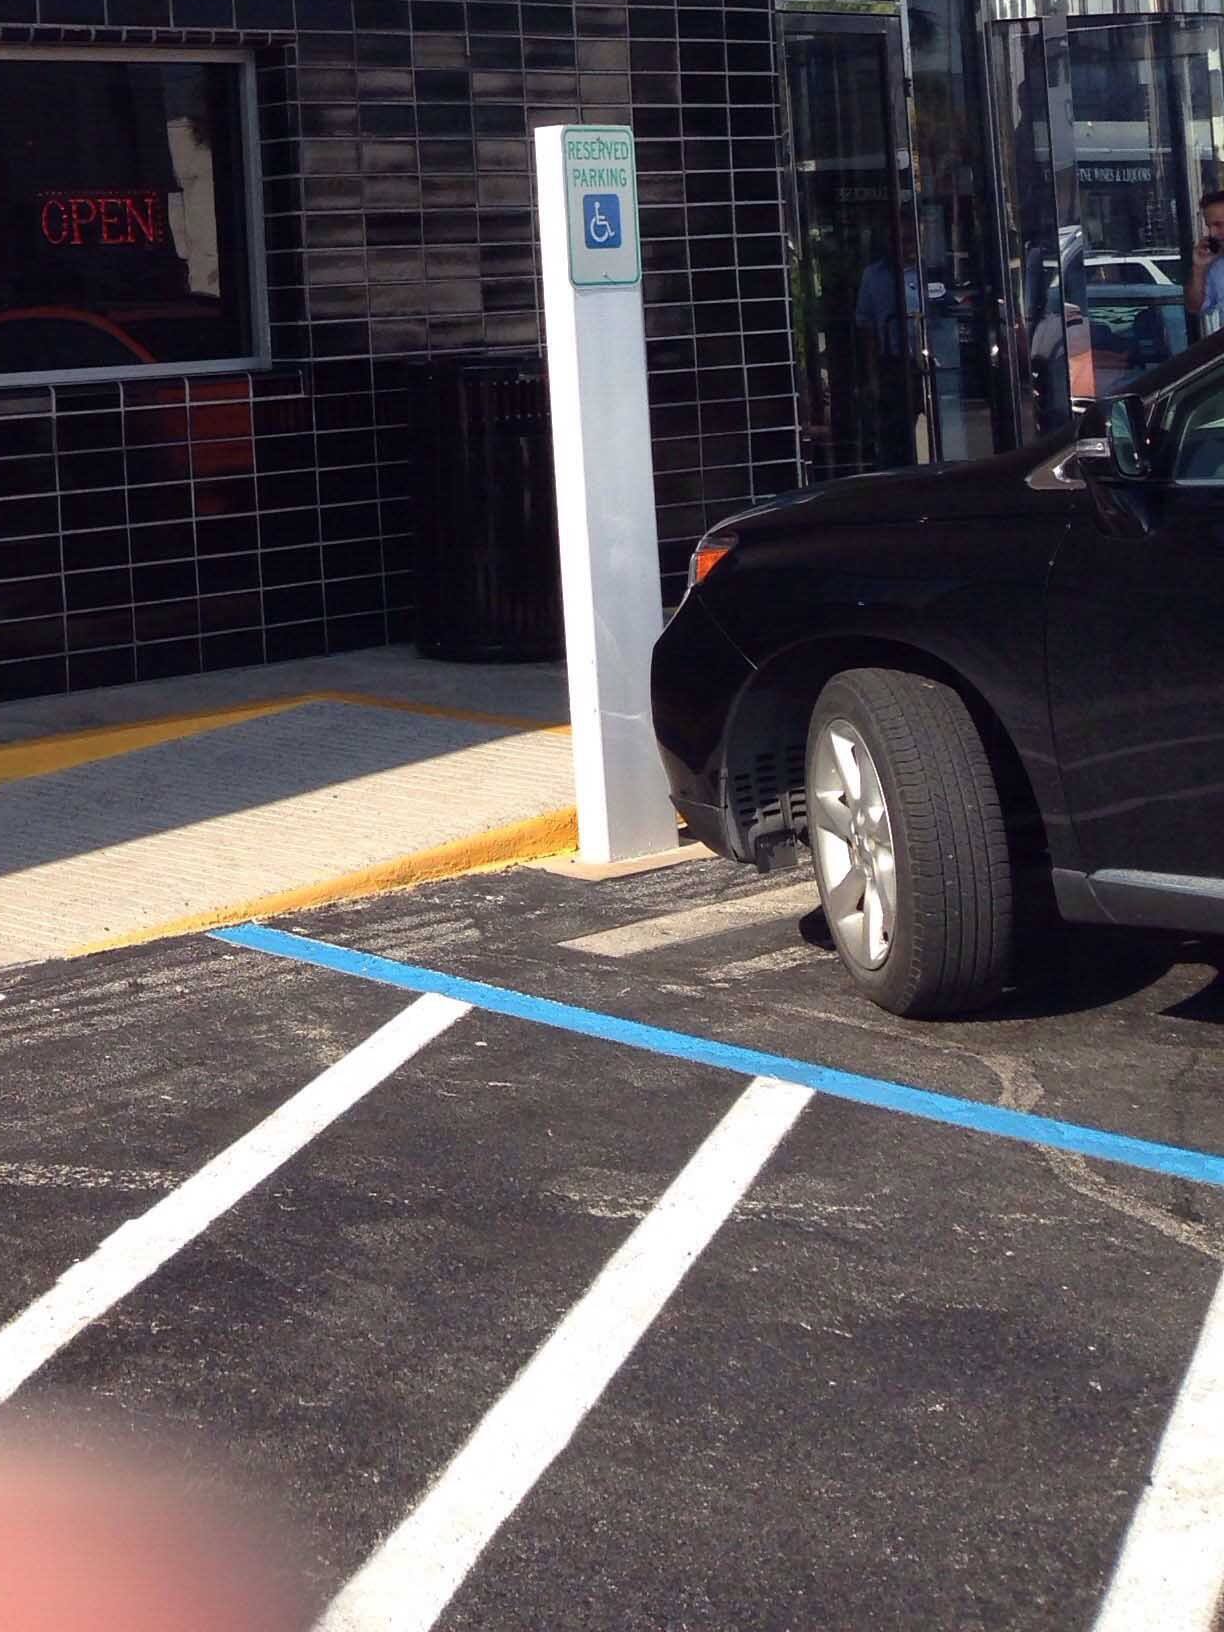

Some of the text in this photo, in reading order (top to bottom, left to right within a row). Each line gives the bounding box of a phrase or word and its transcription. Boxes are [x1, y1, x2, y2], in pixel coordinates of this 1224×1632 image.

[567, 140, 630, 161] RESERVED
[573, 168, 628, 188] PARKING
[41, 197, 157, 245] OPEN
